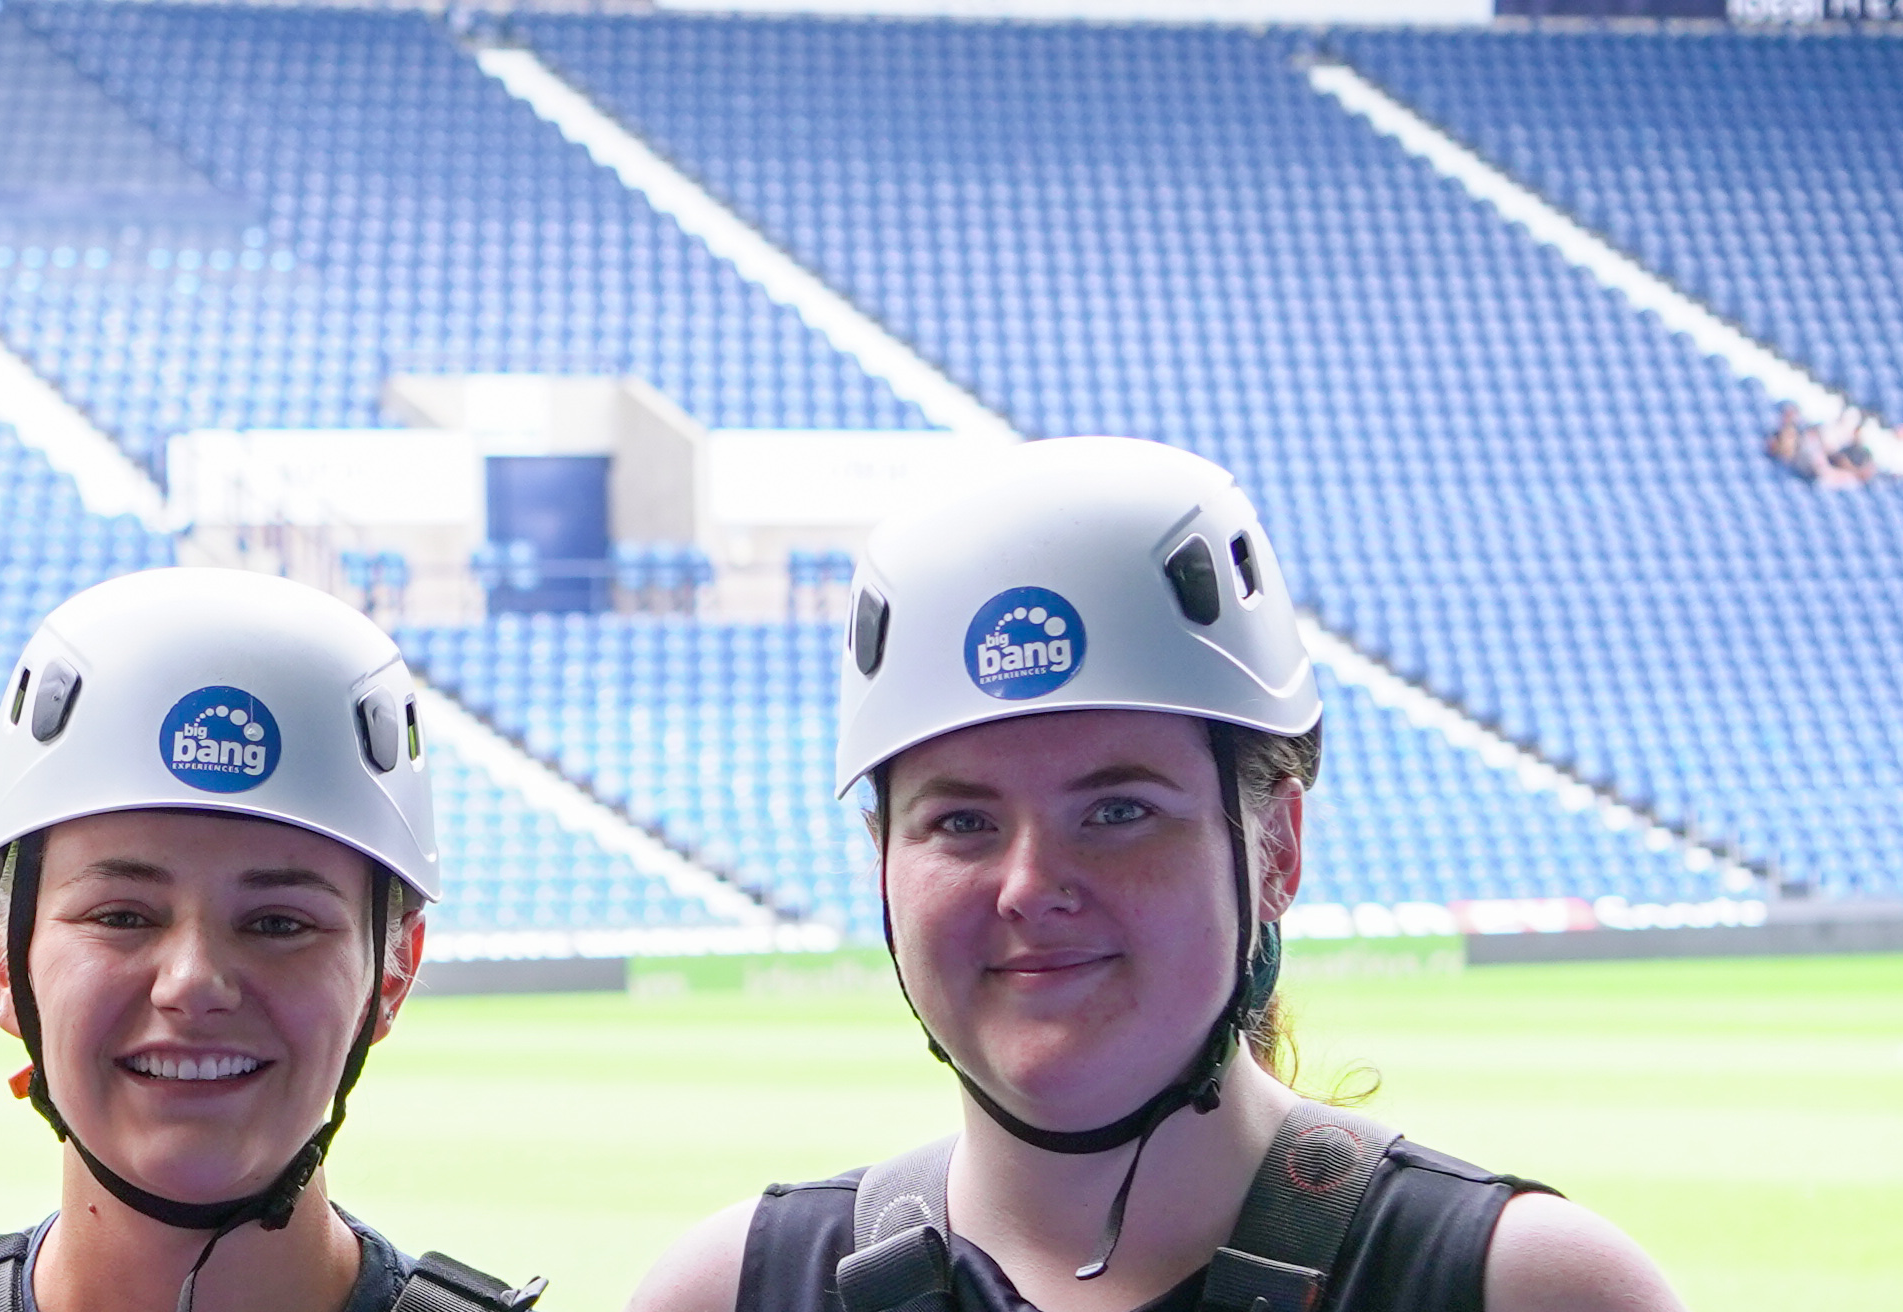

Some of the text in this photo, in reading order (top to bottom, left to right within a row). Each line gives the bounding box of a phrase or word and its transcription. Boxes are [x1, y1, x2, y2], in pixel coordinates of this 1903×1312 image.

[985, 632, 1009, 648] big
[978, 639, 1072, 677] bang
[979, 667, 1047, 685] EXPERIENCES
[184, 723, 208, 740] big
[173, 731, 266, 776] bang
[172, 762, 240, 774] EXPERIENCES
